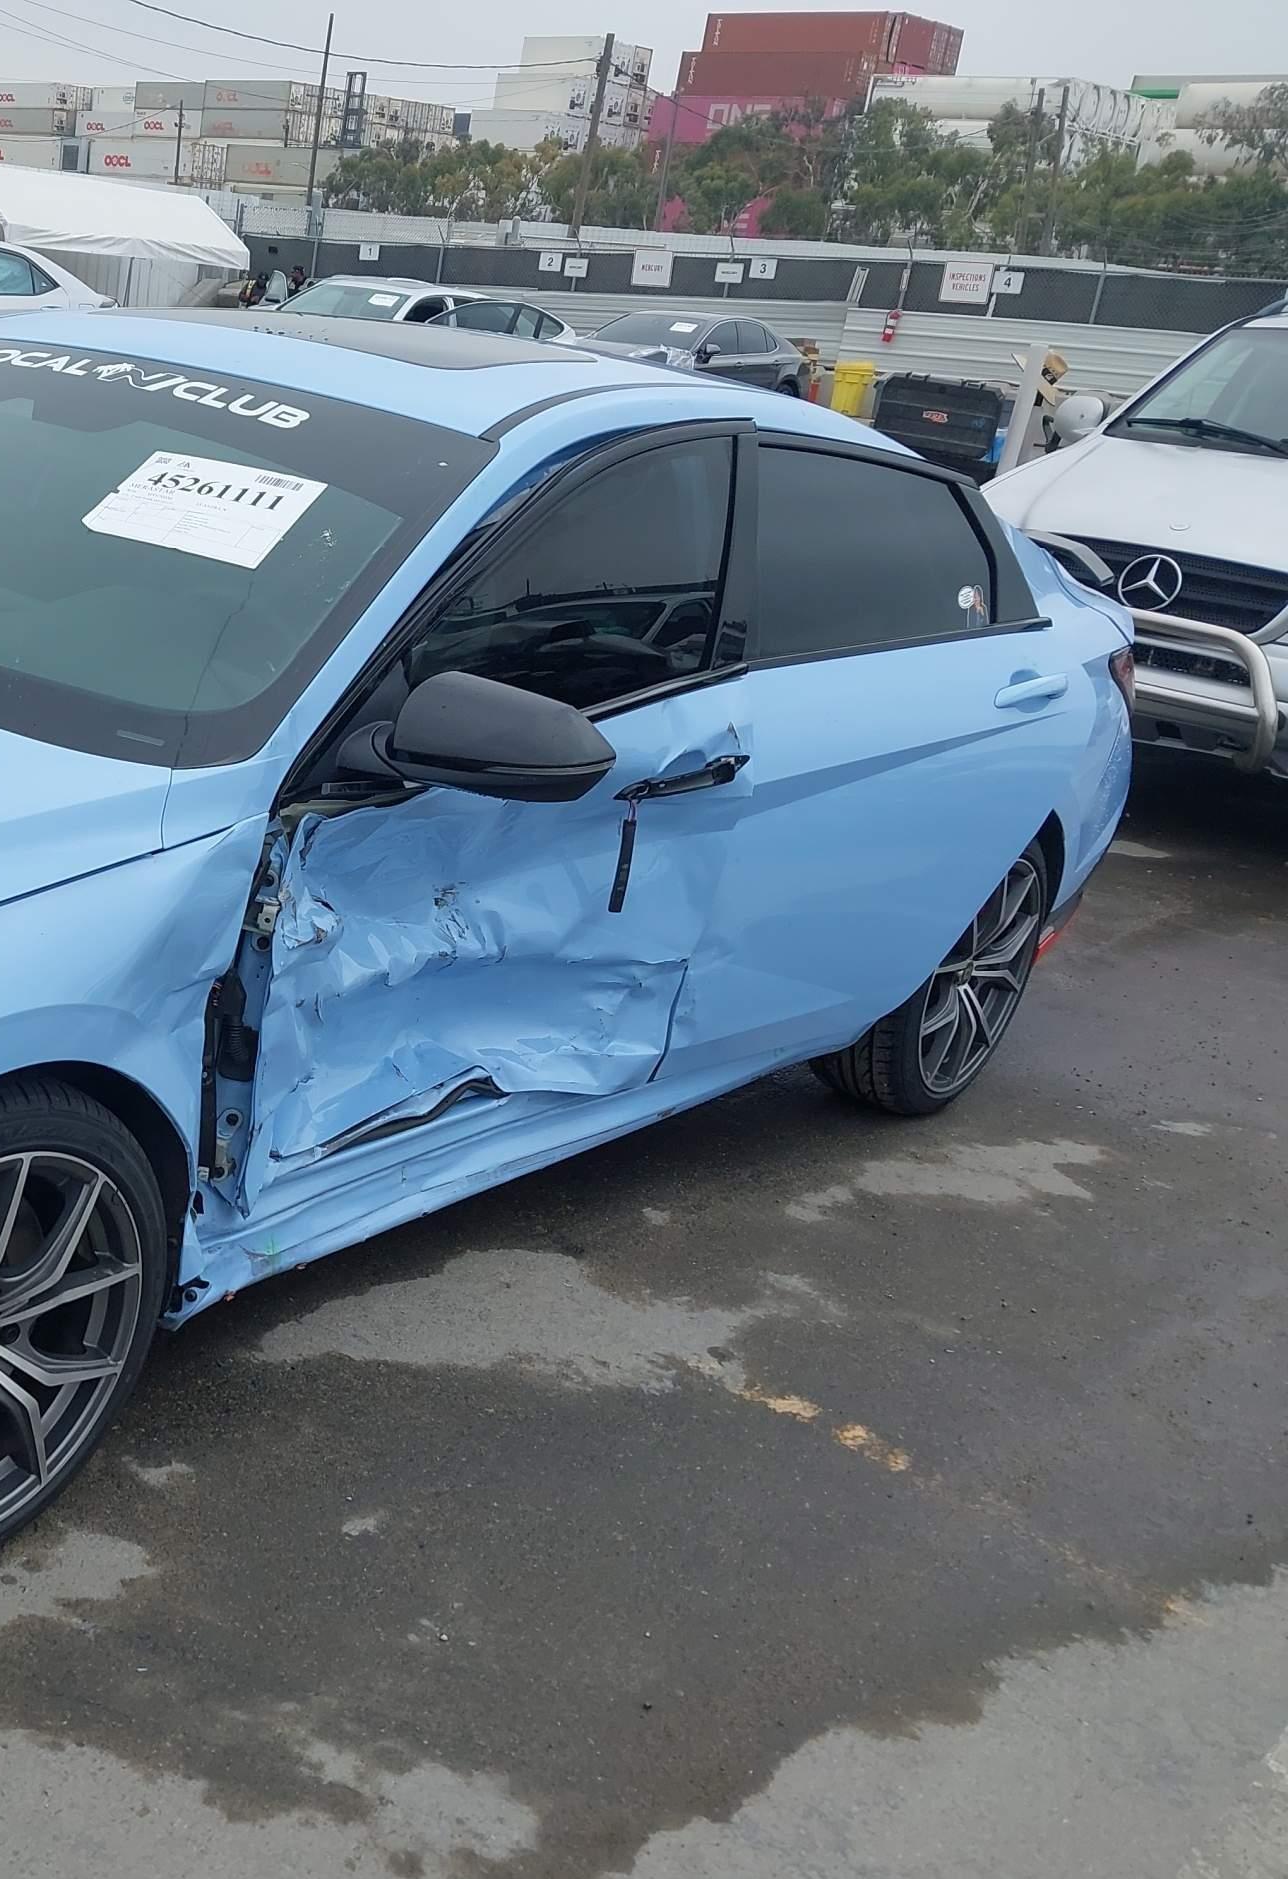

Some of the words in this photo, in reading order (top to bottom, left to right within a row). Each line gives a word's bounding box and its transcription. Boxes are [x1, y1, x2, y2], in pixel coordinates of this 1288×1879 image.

[104, 154, 131, 167] OOCL
[547, 256, 554, 267] 2
[640, 264, 663, 273] MERCURY
[759, 263, 767, 274] 3
[948, 272, 986, 282] INSPECTIONS
[1003, 277, 1011, 288] 4
[951, 283, 980, 292] VEHICLES
[173, 381, 311, 429] CLUB
[148, 472, 285, 510] 45261111
